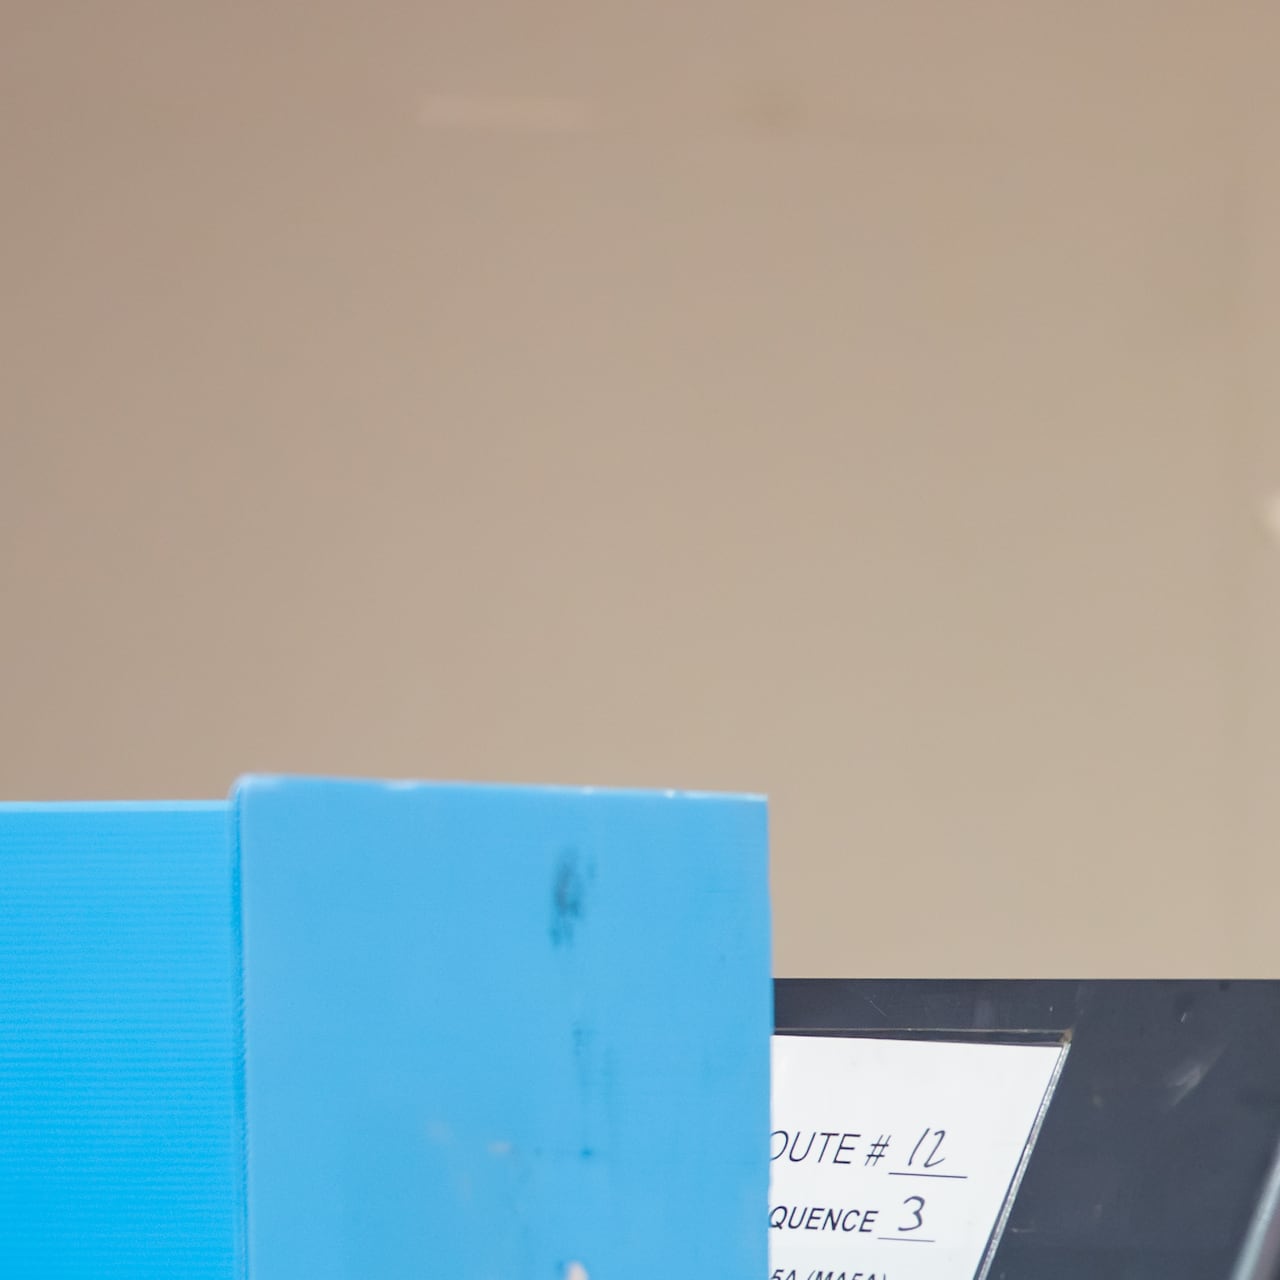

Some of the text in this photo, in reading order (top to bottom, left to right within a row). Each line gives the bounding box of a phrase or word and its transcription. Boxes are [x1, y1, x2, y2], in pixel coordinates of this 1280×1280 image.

[864, 1134, 892, 1167] #
[907, 1127, 946, 1168] 12
[768, 1195, 926, 1233] QUENCE 3
